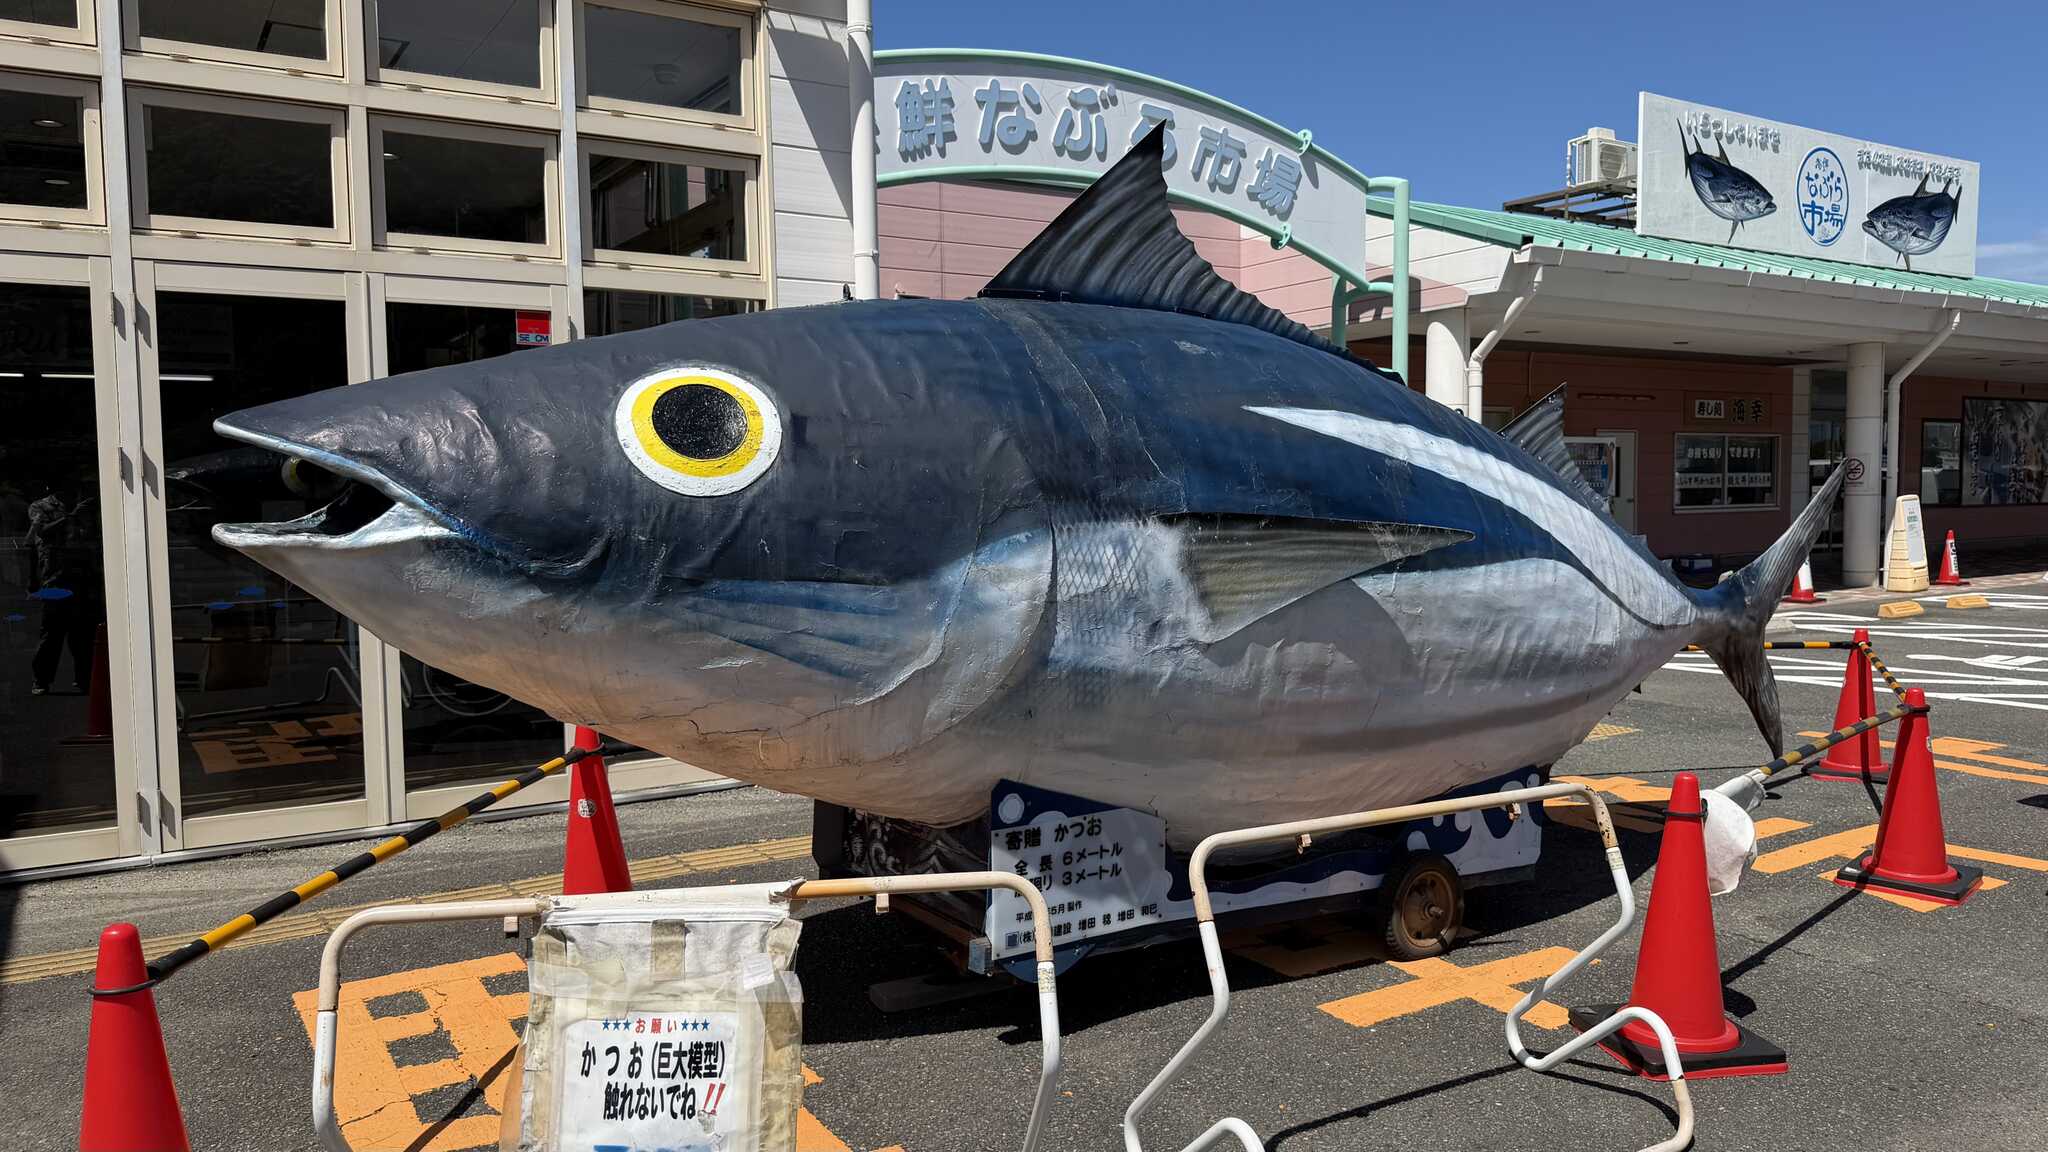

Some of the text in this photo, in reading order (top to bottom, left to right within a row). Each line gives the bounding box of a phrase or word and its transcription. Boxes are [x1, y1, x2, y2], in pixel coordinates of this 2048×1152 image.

[874, 77, 1302, 214] 鮮なぶら市場
[1805, 171, 1843, 202] なぶら
[1802, 200, 1843, 236] 市場
[1005, 817, 1102, 851] 寄贈 かつお
[1014, 843, 1123, 876] 全長 6メートル
[1014, 864, 1122, 898] 廻り 3メートル
[1016, 900, 1082, 923] 平成5月 製作
[1078, 917, 1096, 931] 増田
[1118, 909, 1135, 922] 増田
[634, 1017, 679, 1034] お願い
[580, 1040, 727, 1081] かつお(巨大模型)
[602, 1082, 727, 1121] 触れないでね!!
